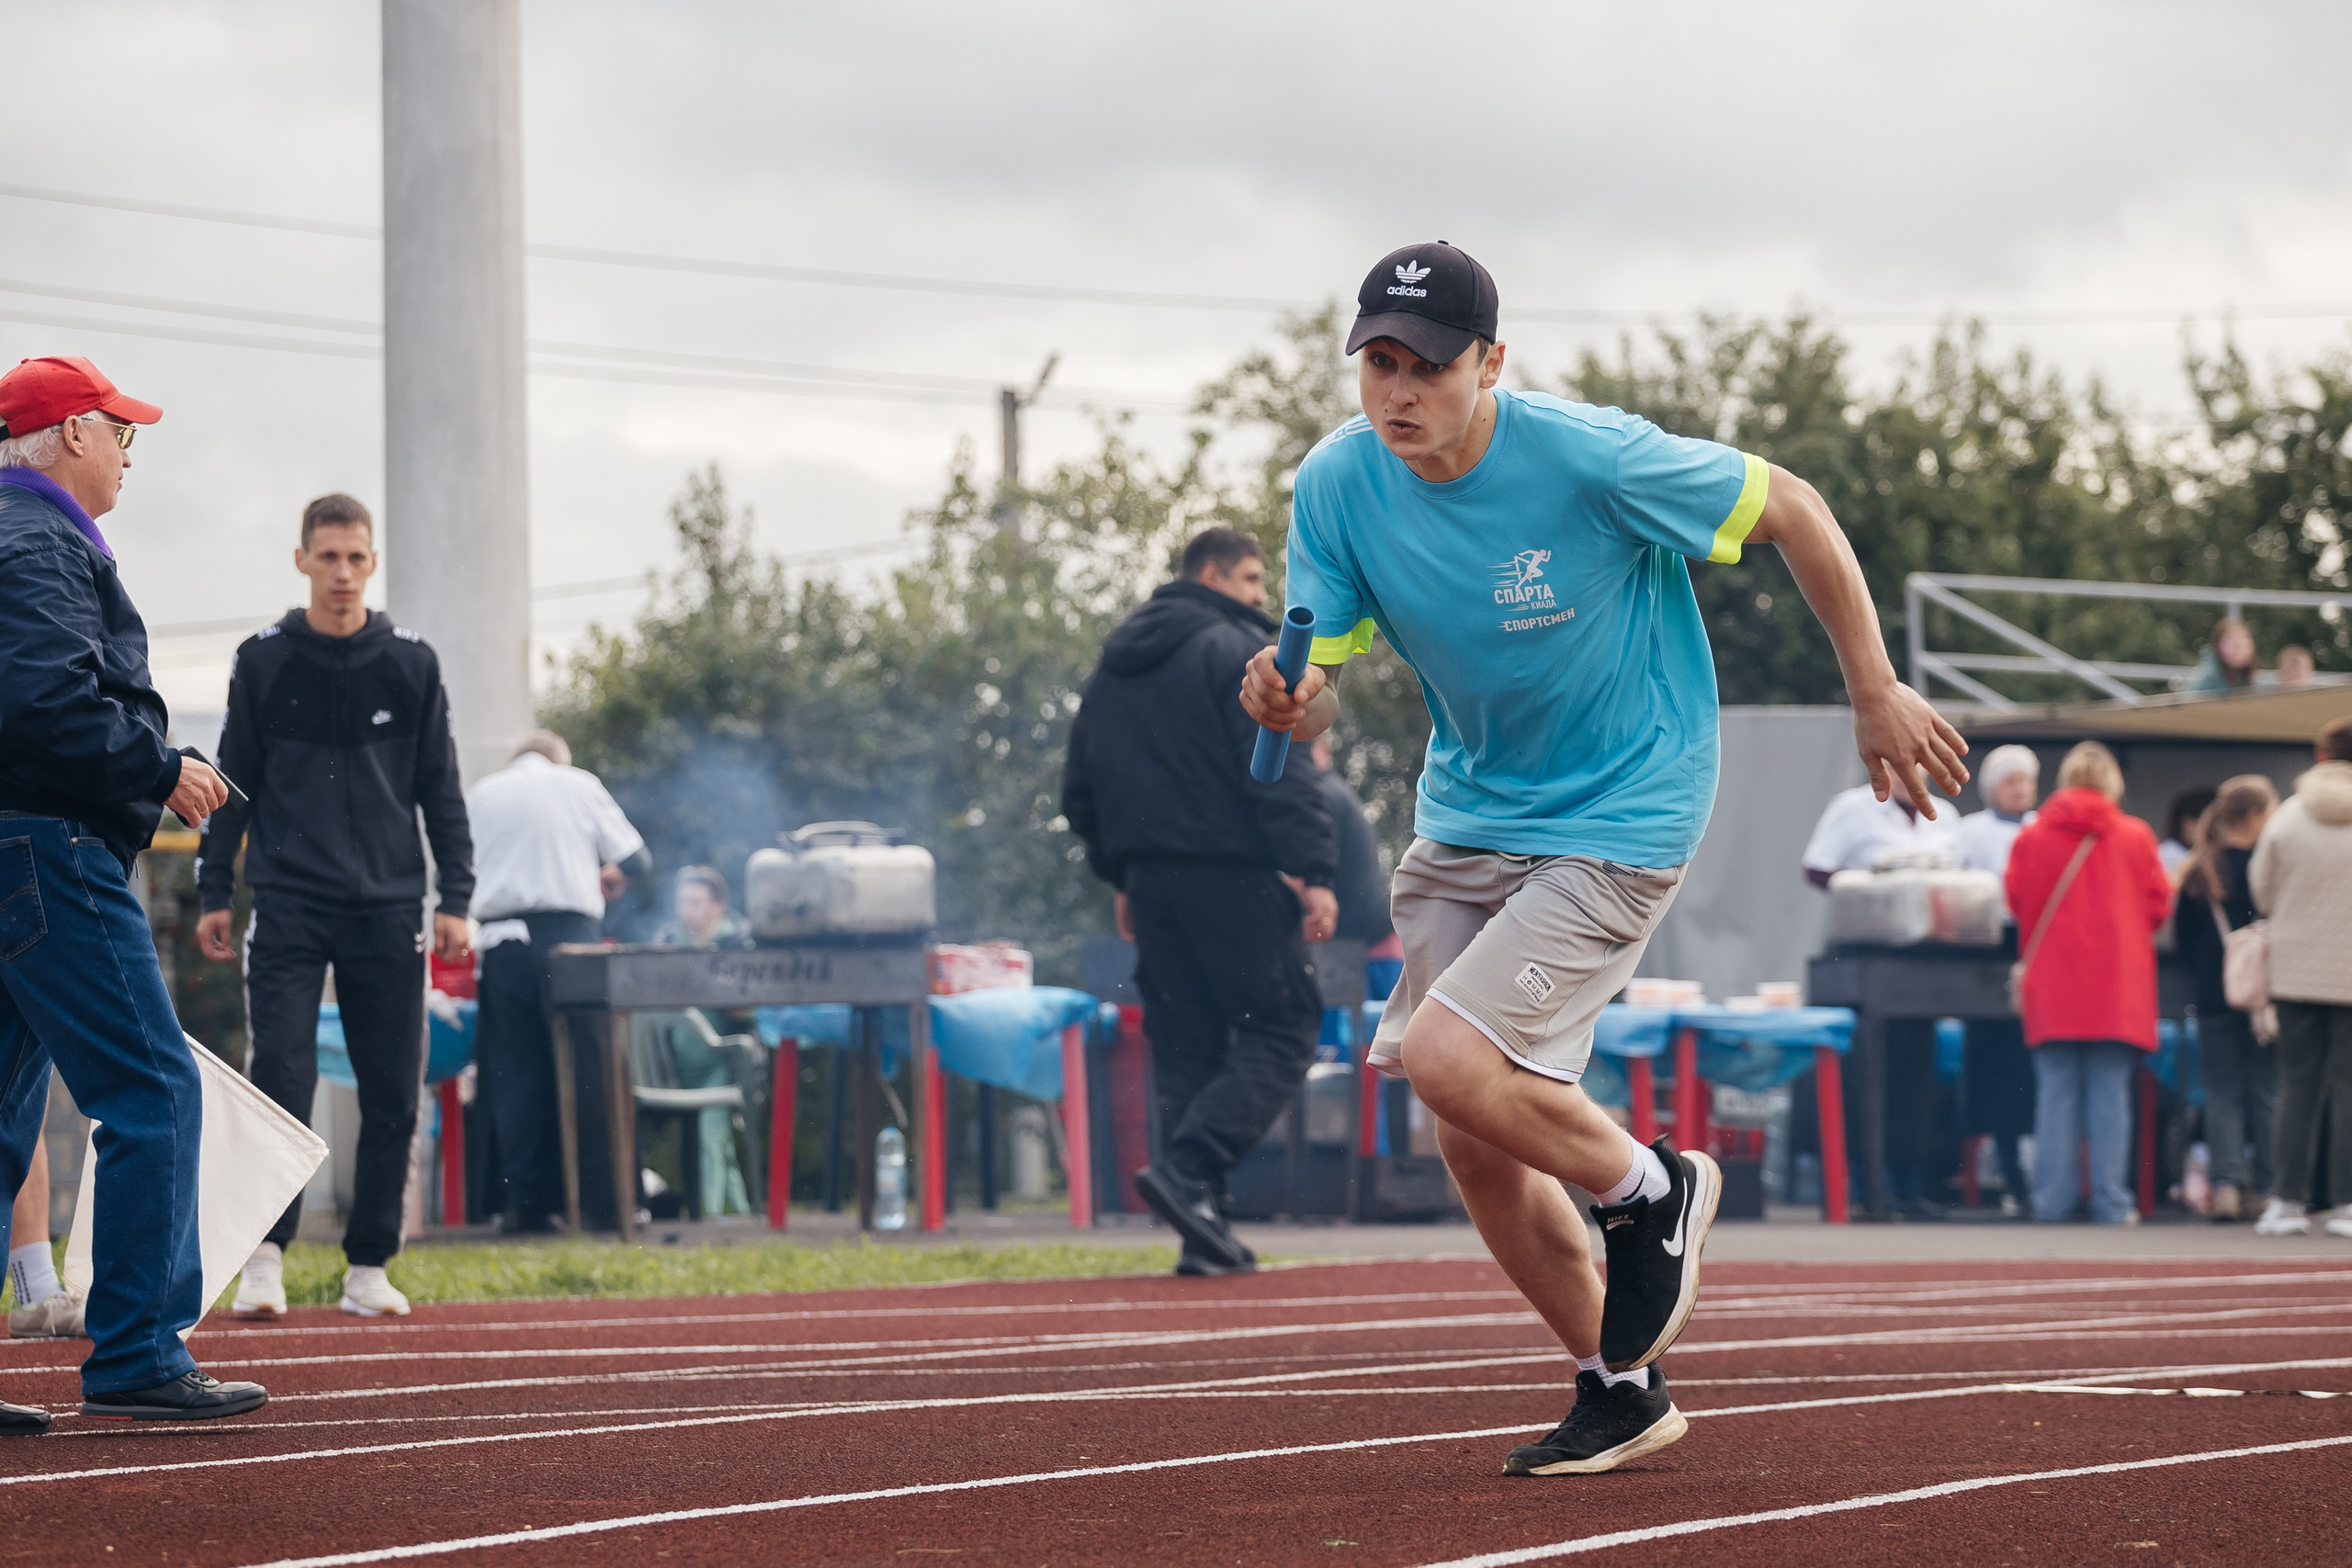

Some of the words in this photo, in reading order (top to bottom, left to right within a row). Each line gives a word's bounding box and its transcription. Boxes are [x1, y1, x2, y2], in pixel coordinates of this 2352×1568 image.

[1386, 285, 1428, 298] adidas
[1494, 583, 1555, 604] СПАРТА
[1530, 599, 1556, 610] КИАДА
[1503, 607, 1576, 632] СПОРТСМЕН
[1608, 1213, 1630, 1224] NIKE
